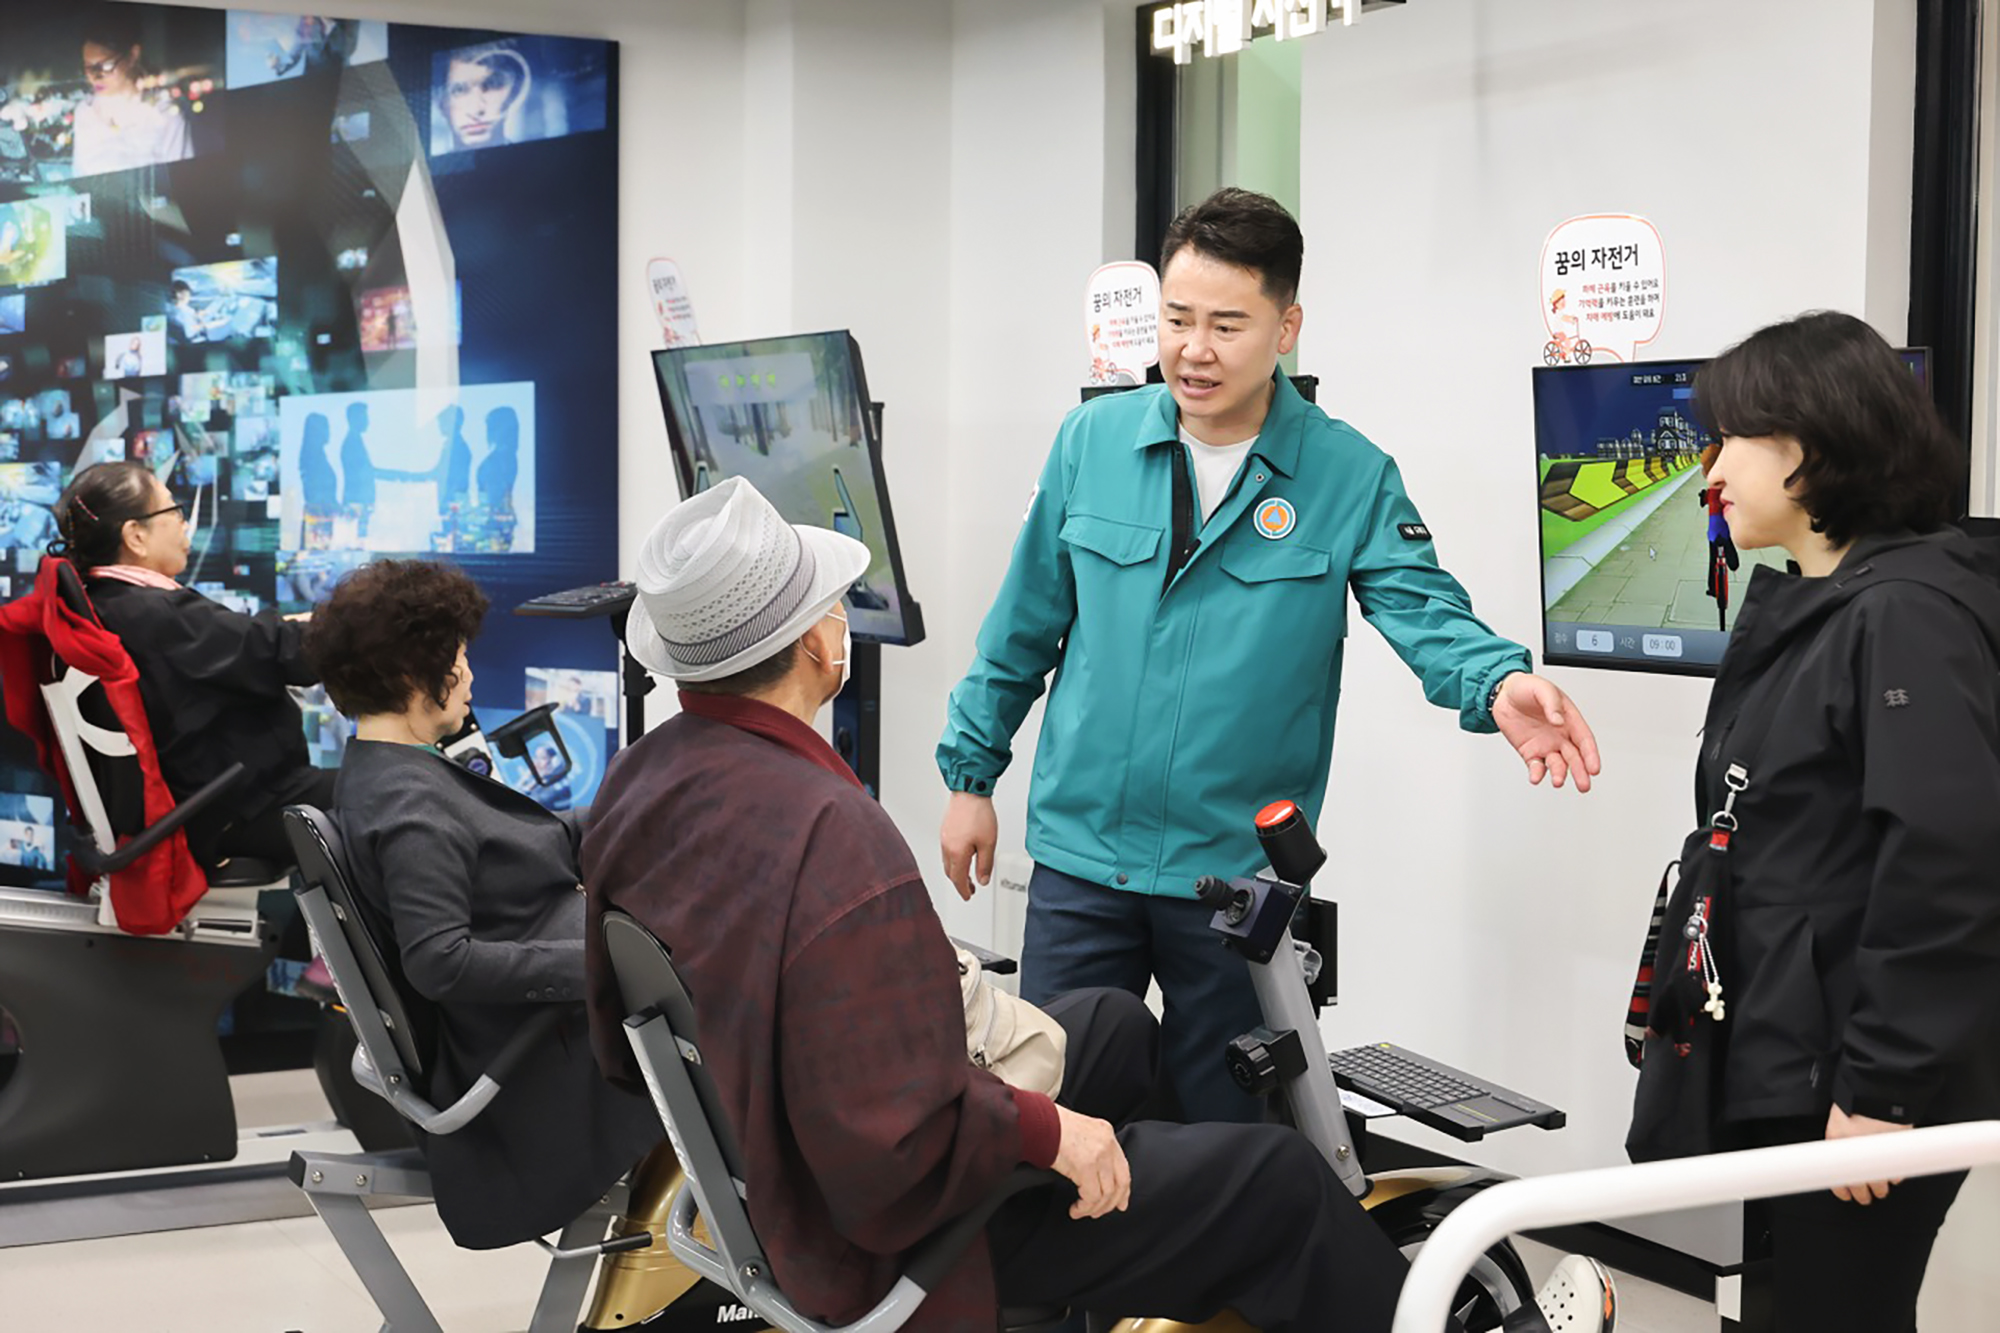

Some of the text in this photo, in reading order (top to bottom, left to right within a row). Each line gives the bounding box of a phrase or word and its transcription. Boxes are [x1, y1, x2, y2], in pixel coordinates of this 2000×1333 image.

[1554, 243, 1638, 276] 꿈의 자전거
[1093, 286, 1142, 313] 꿈의 자전거
[1591, 634, 1598, 647] 6
[1619, 636, 1636, 650] 시간
[1649, 638, 1676, 651] 09:00
